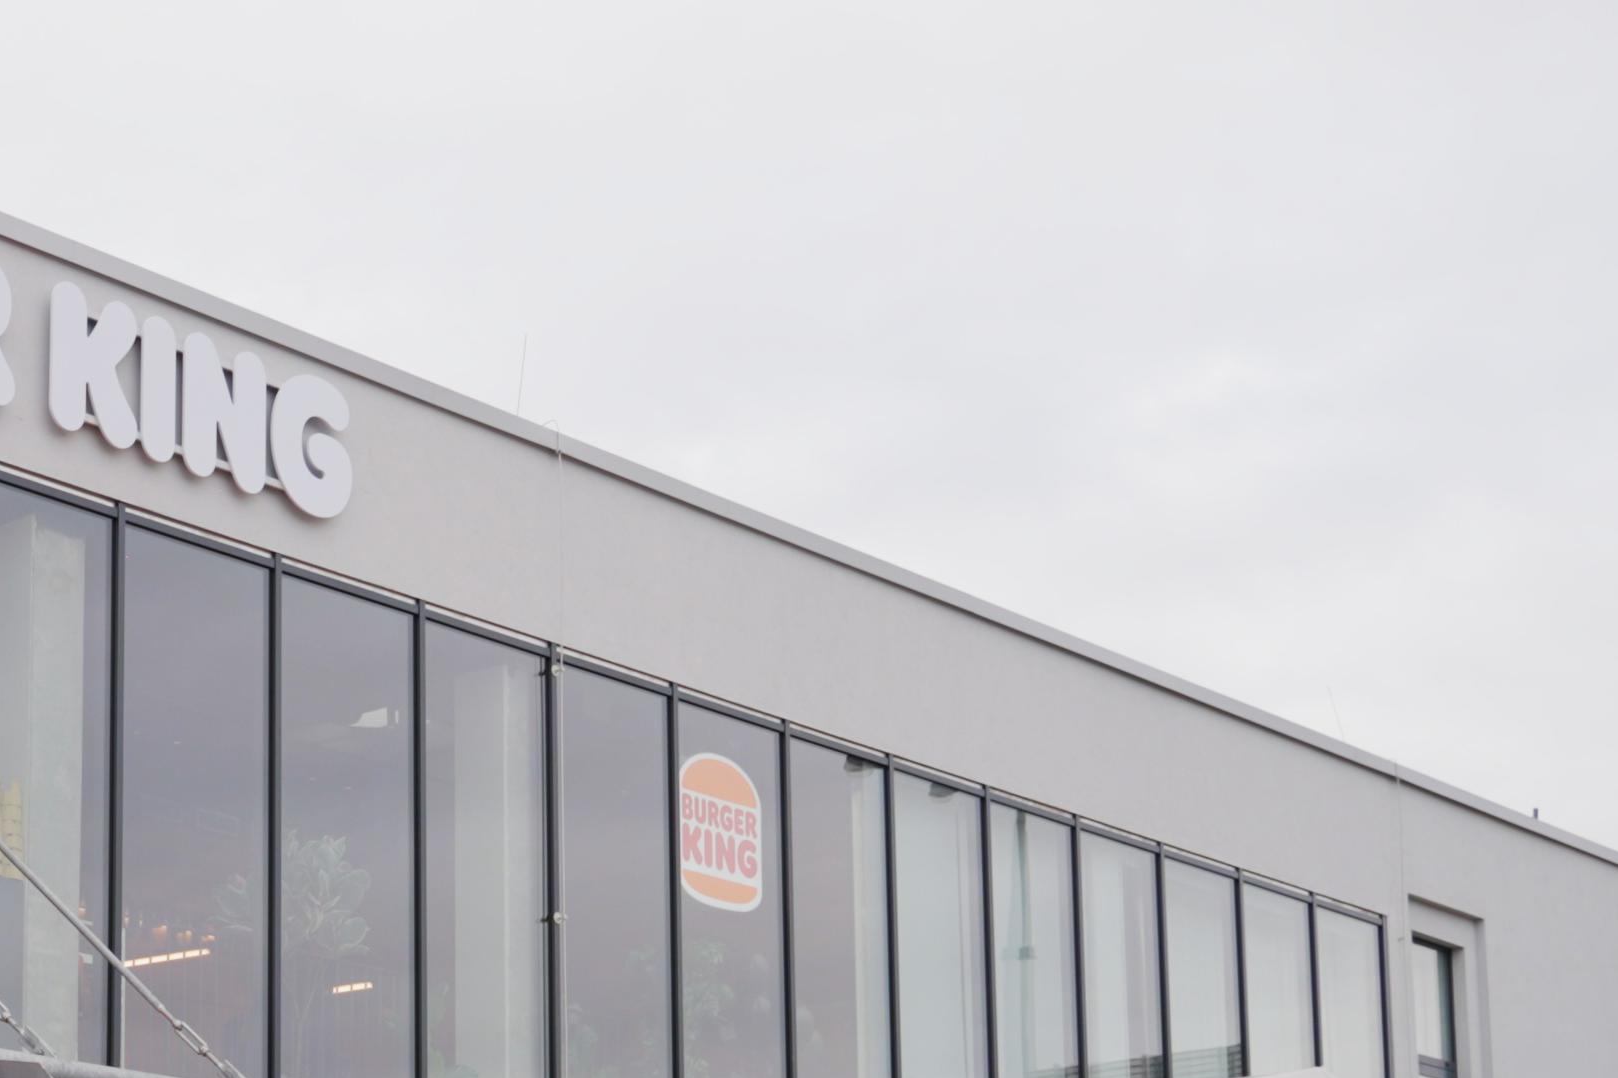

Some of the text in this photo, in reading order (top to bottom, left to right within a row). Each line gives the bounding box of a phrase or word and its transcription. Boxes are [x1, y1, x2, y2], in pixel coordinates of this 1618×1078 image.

[50, 281, 353, 519] KING
[681, 792, 758, 839] BURGER
[681, 821, 759, 879] KING
